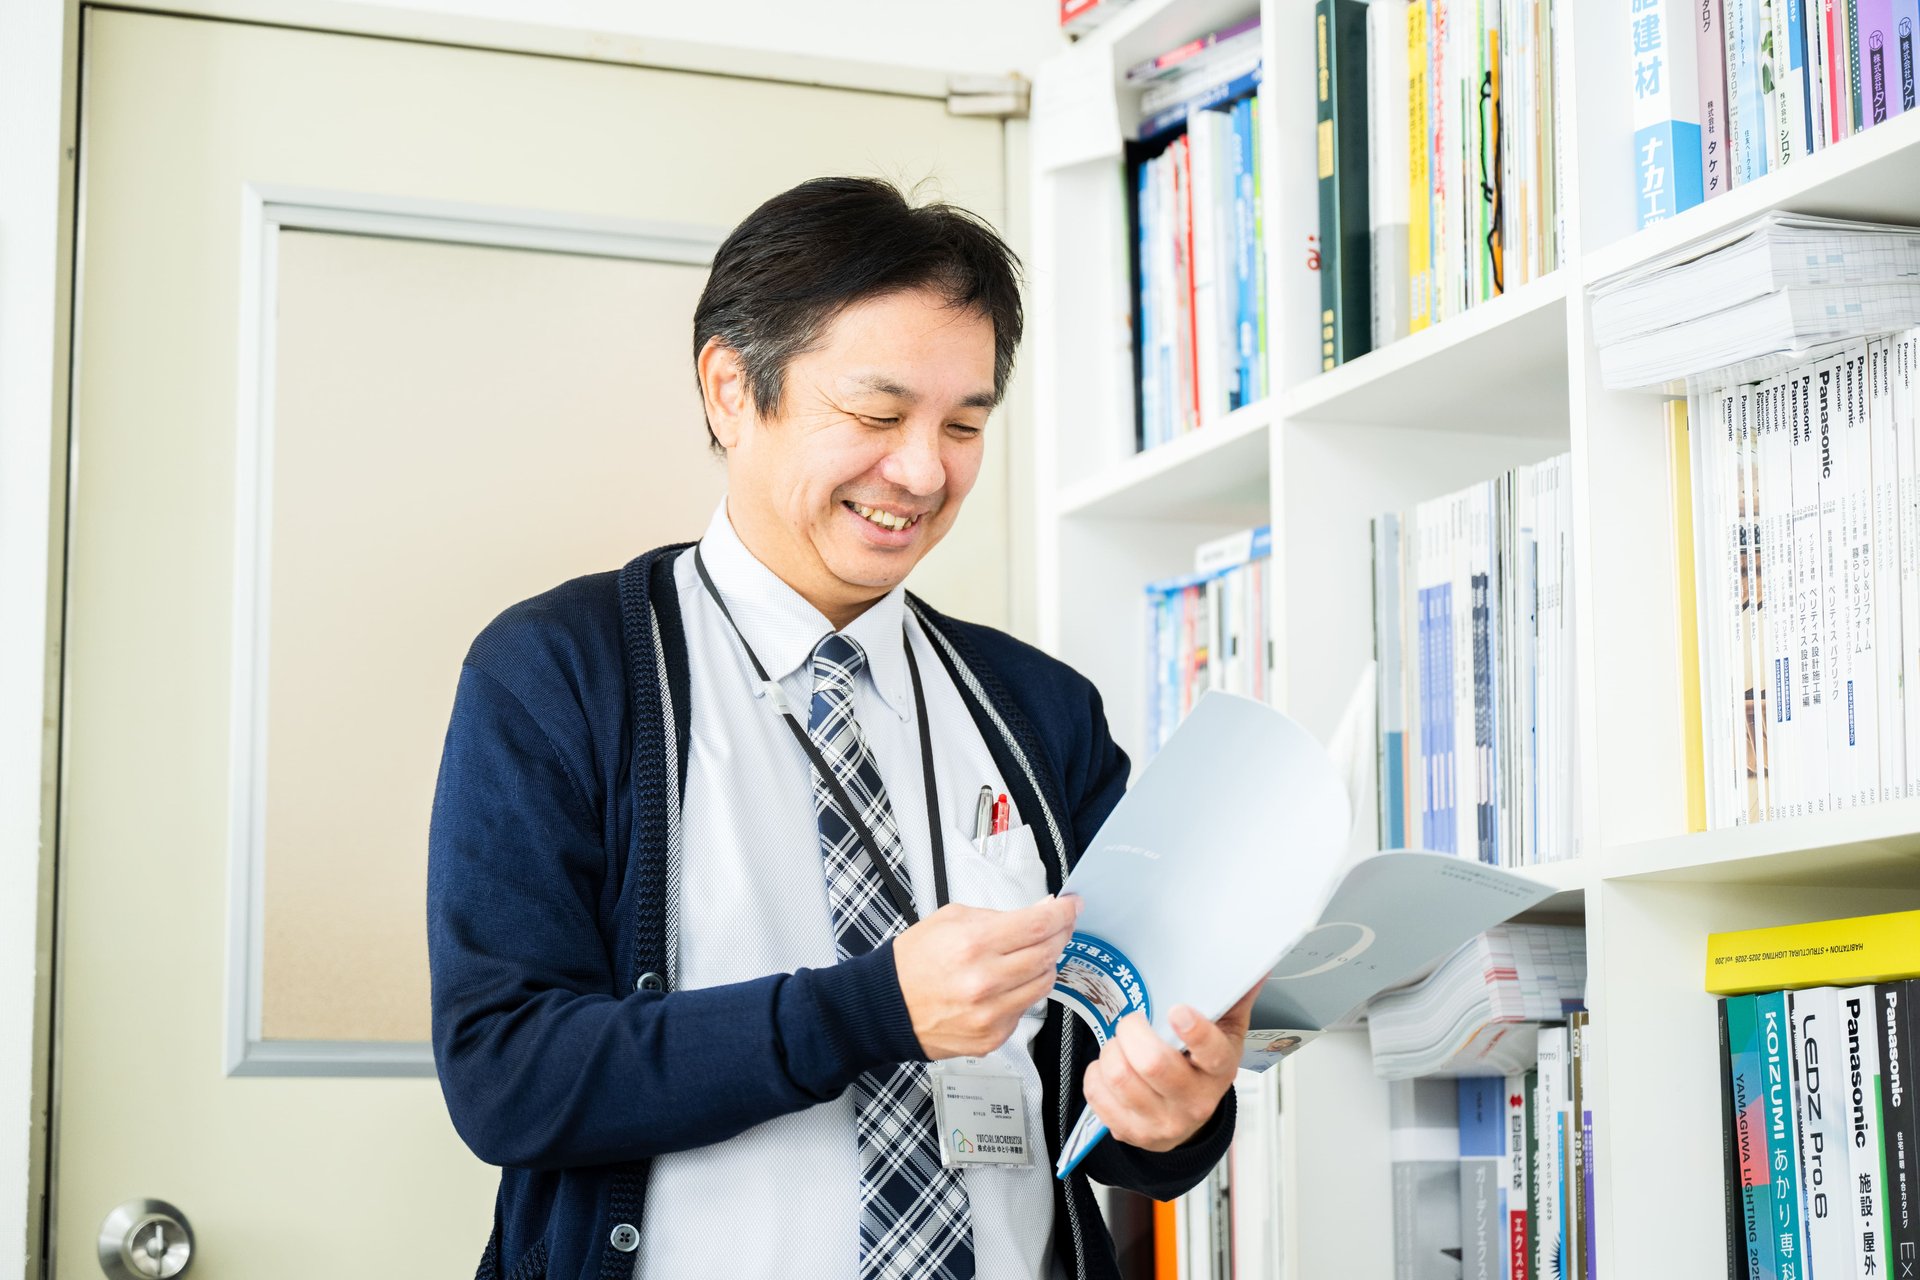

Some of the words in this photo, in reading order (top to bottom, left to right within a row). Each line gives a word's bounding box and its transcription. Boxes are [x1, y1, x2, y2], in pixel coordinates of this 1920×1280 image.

[1708, 141, 1718, 191] タケダ
[1802, 376, 1810, 442] Panasonic
[1820, 370, 1834, 479] Panasonic
[1846, 360, 1854, 428] Panasonic
[1799, 592, 1808, 646] ベリティス
[1810, 588, 1818, 642] ベリティス
[1762, 950, 1788, 960] LIGHTING
[1789, 946, 1824, 958] STRUCTURAL
[1830, 943, 1864, 954] HABITATION
[1765, 1012, 1785, 1140] KOIZUMI
[1803, 1014, 1821, 1121] LEDZ
[1886, 992, 1902, 1108] Panasonic
[1737, 1073, 1752, 1164] YAMAGIWA
[1846, 1000, 1866, 1148] Panasonic
[1859, 1173, 1876, 1276] 施設・屋外
[1744, 1168, 1759, 1243] LIGHTING
[1810, 1132, 1828, 1218] Pro.6
[1774, 1148, 1795, 1280] あかり専科
